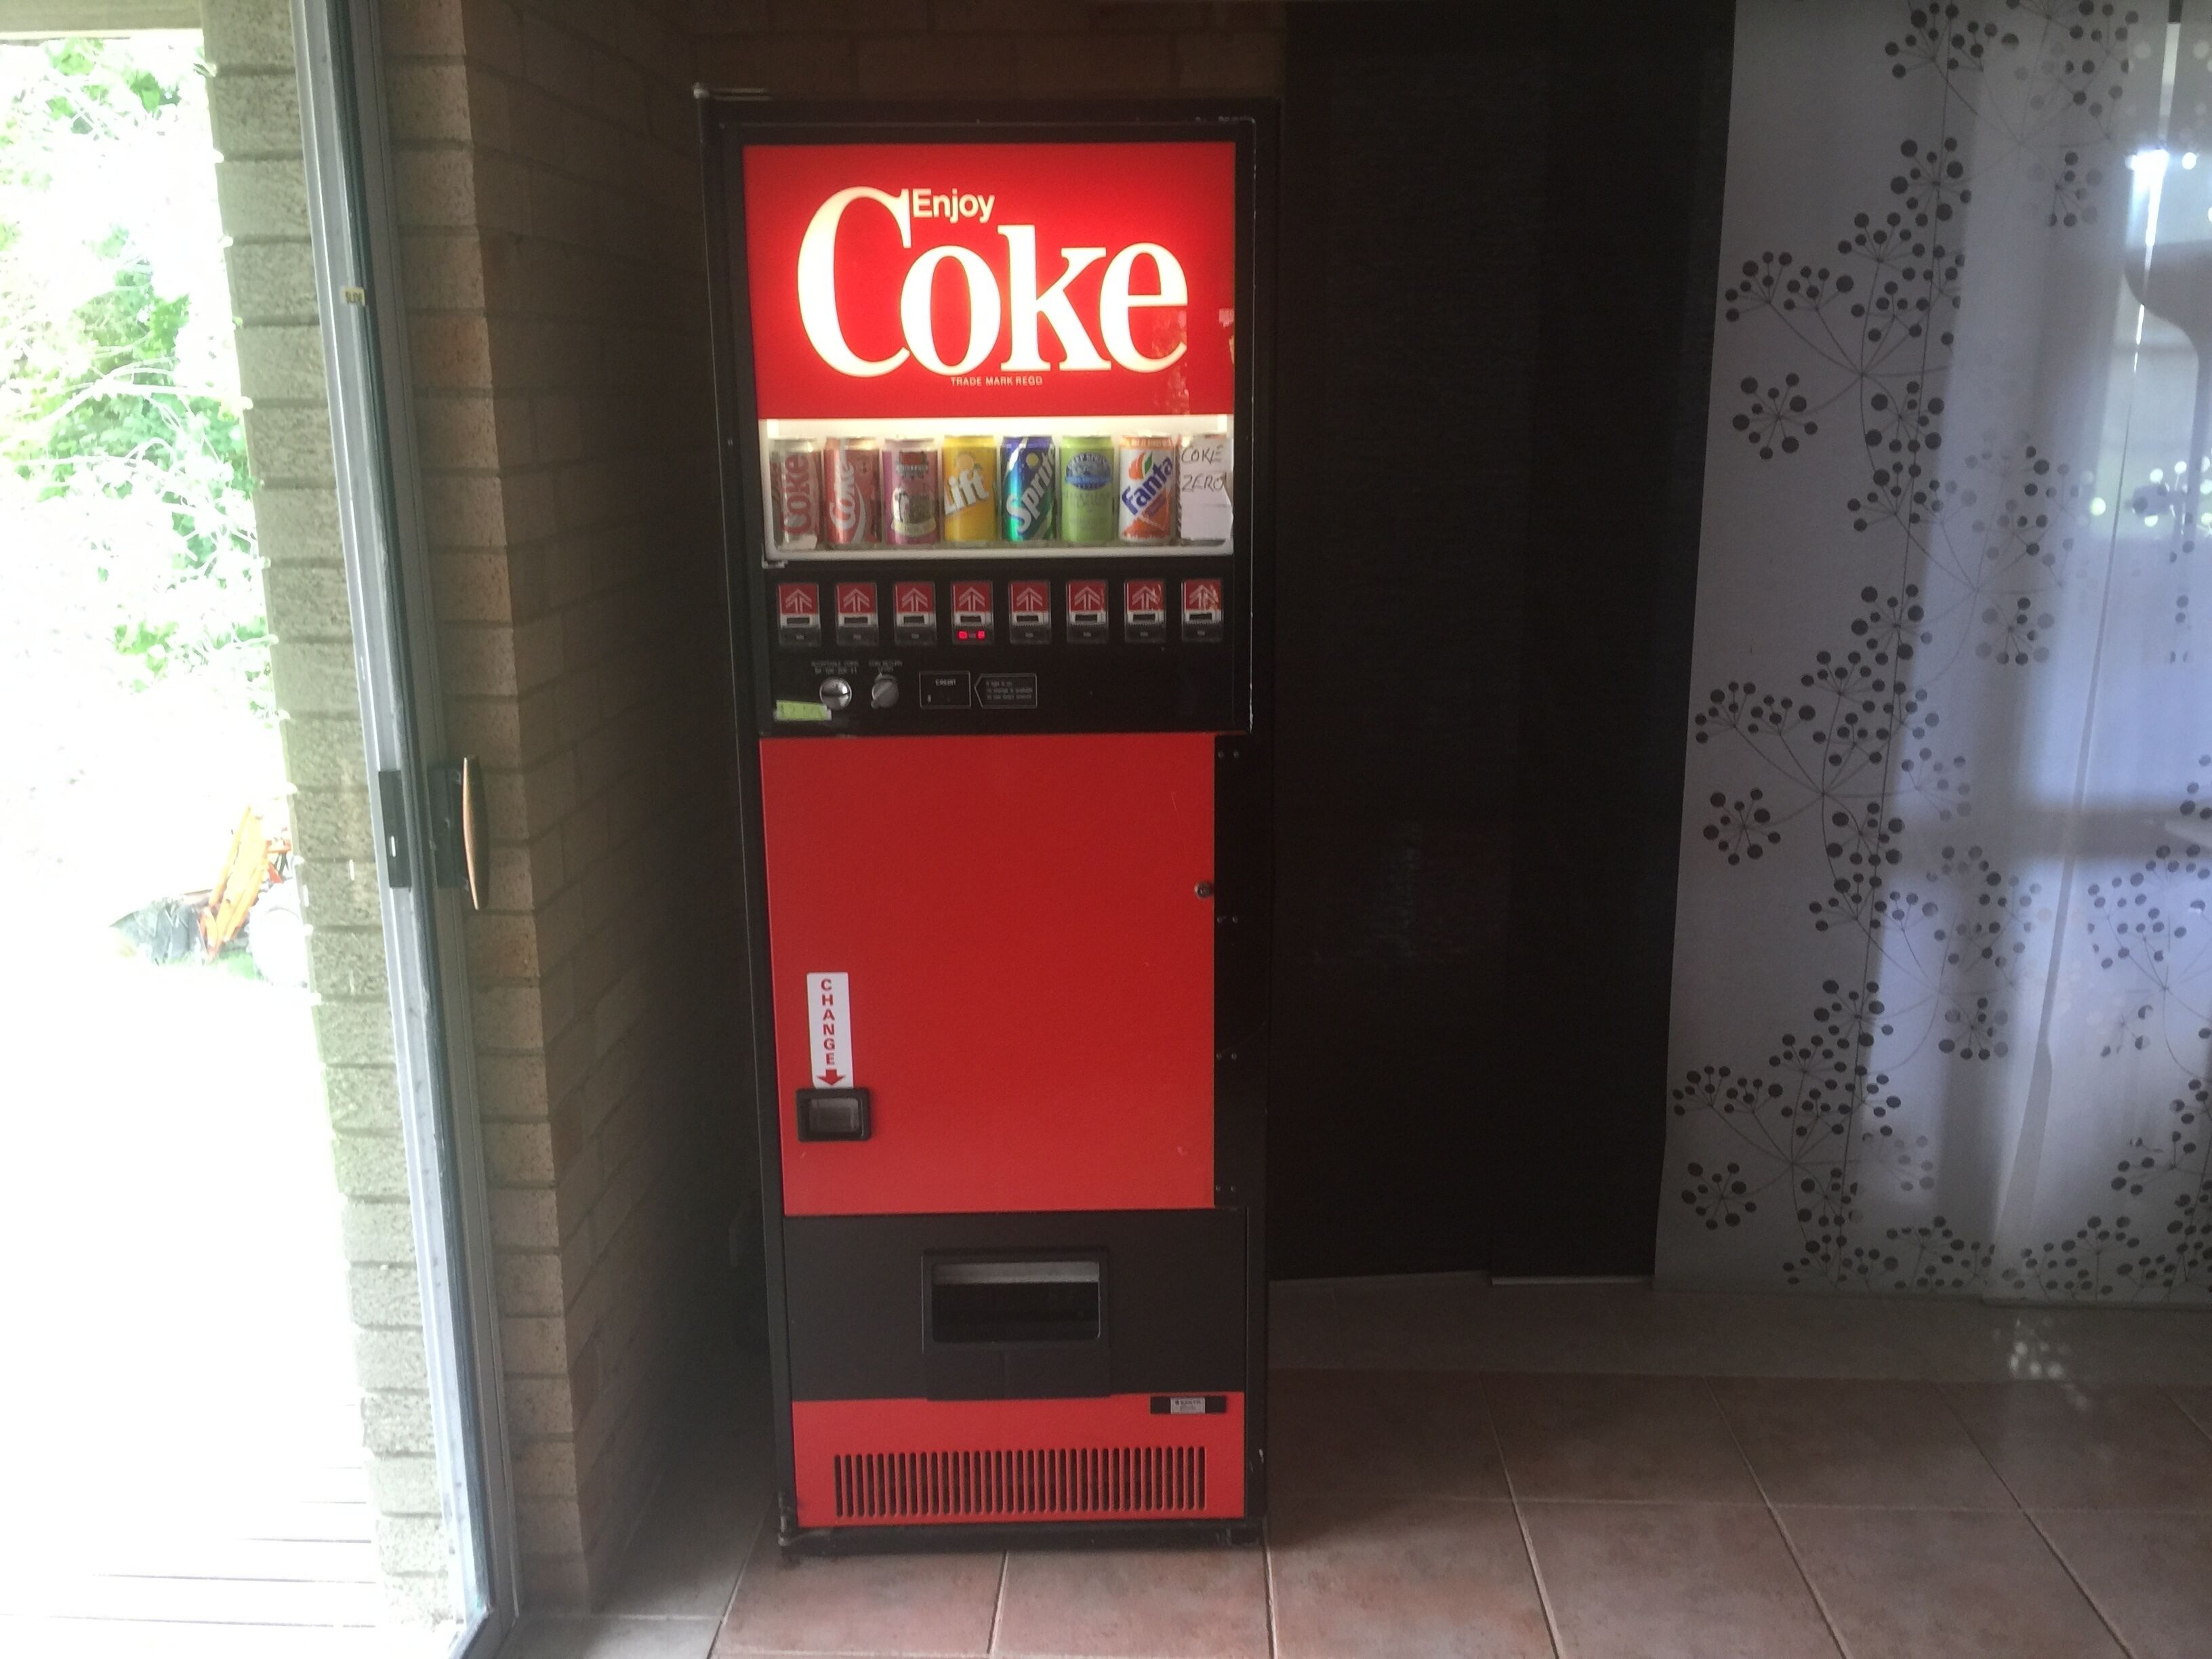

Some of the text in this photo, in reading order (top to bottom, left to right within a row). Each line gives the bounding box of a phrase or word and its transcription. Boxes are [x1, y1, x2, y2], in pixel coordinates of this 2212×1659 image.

[913, 188, 996, 224] Enjoy
[797, 185, 1189, 378] Coke
[951, 376, 982, 387] TRADE
[985, 375, 1013, 386] MARK
[1181, 445, 1223, 465] COKE
[780, 455, 812, 535] Coke
[944, 468, 989, 515] Lift
[1181, 473, 1225, 493] ZERO
[821, 978, 836, 1065] CHANGE
